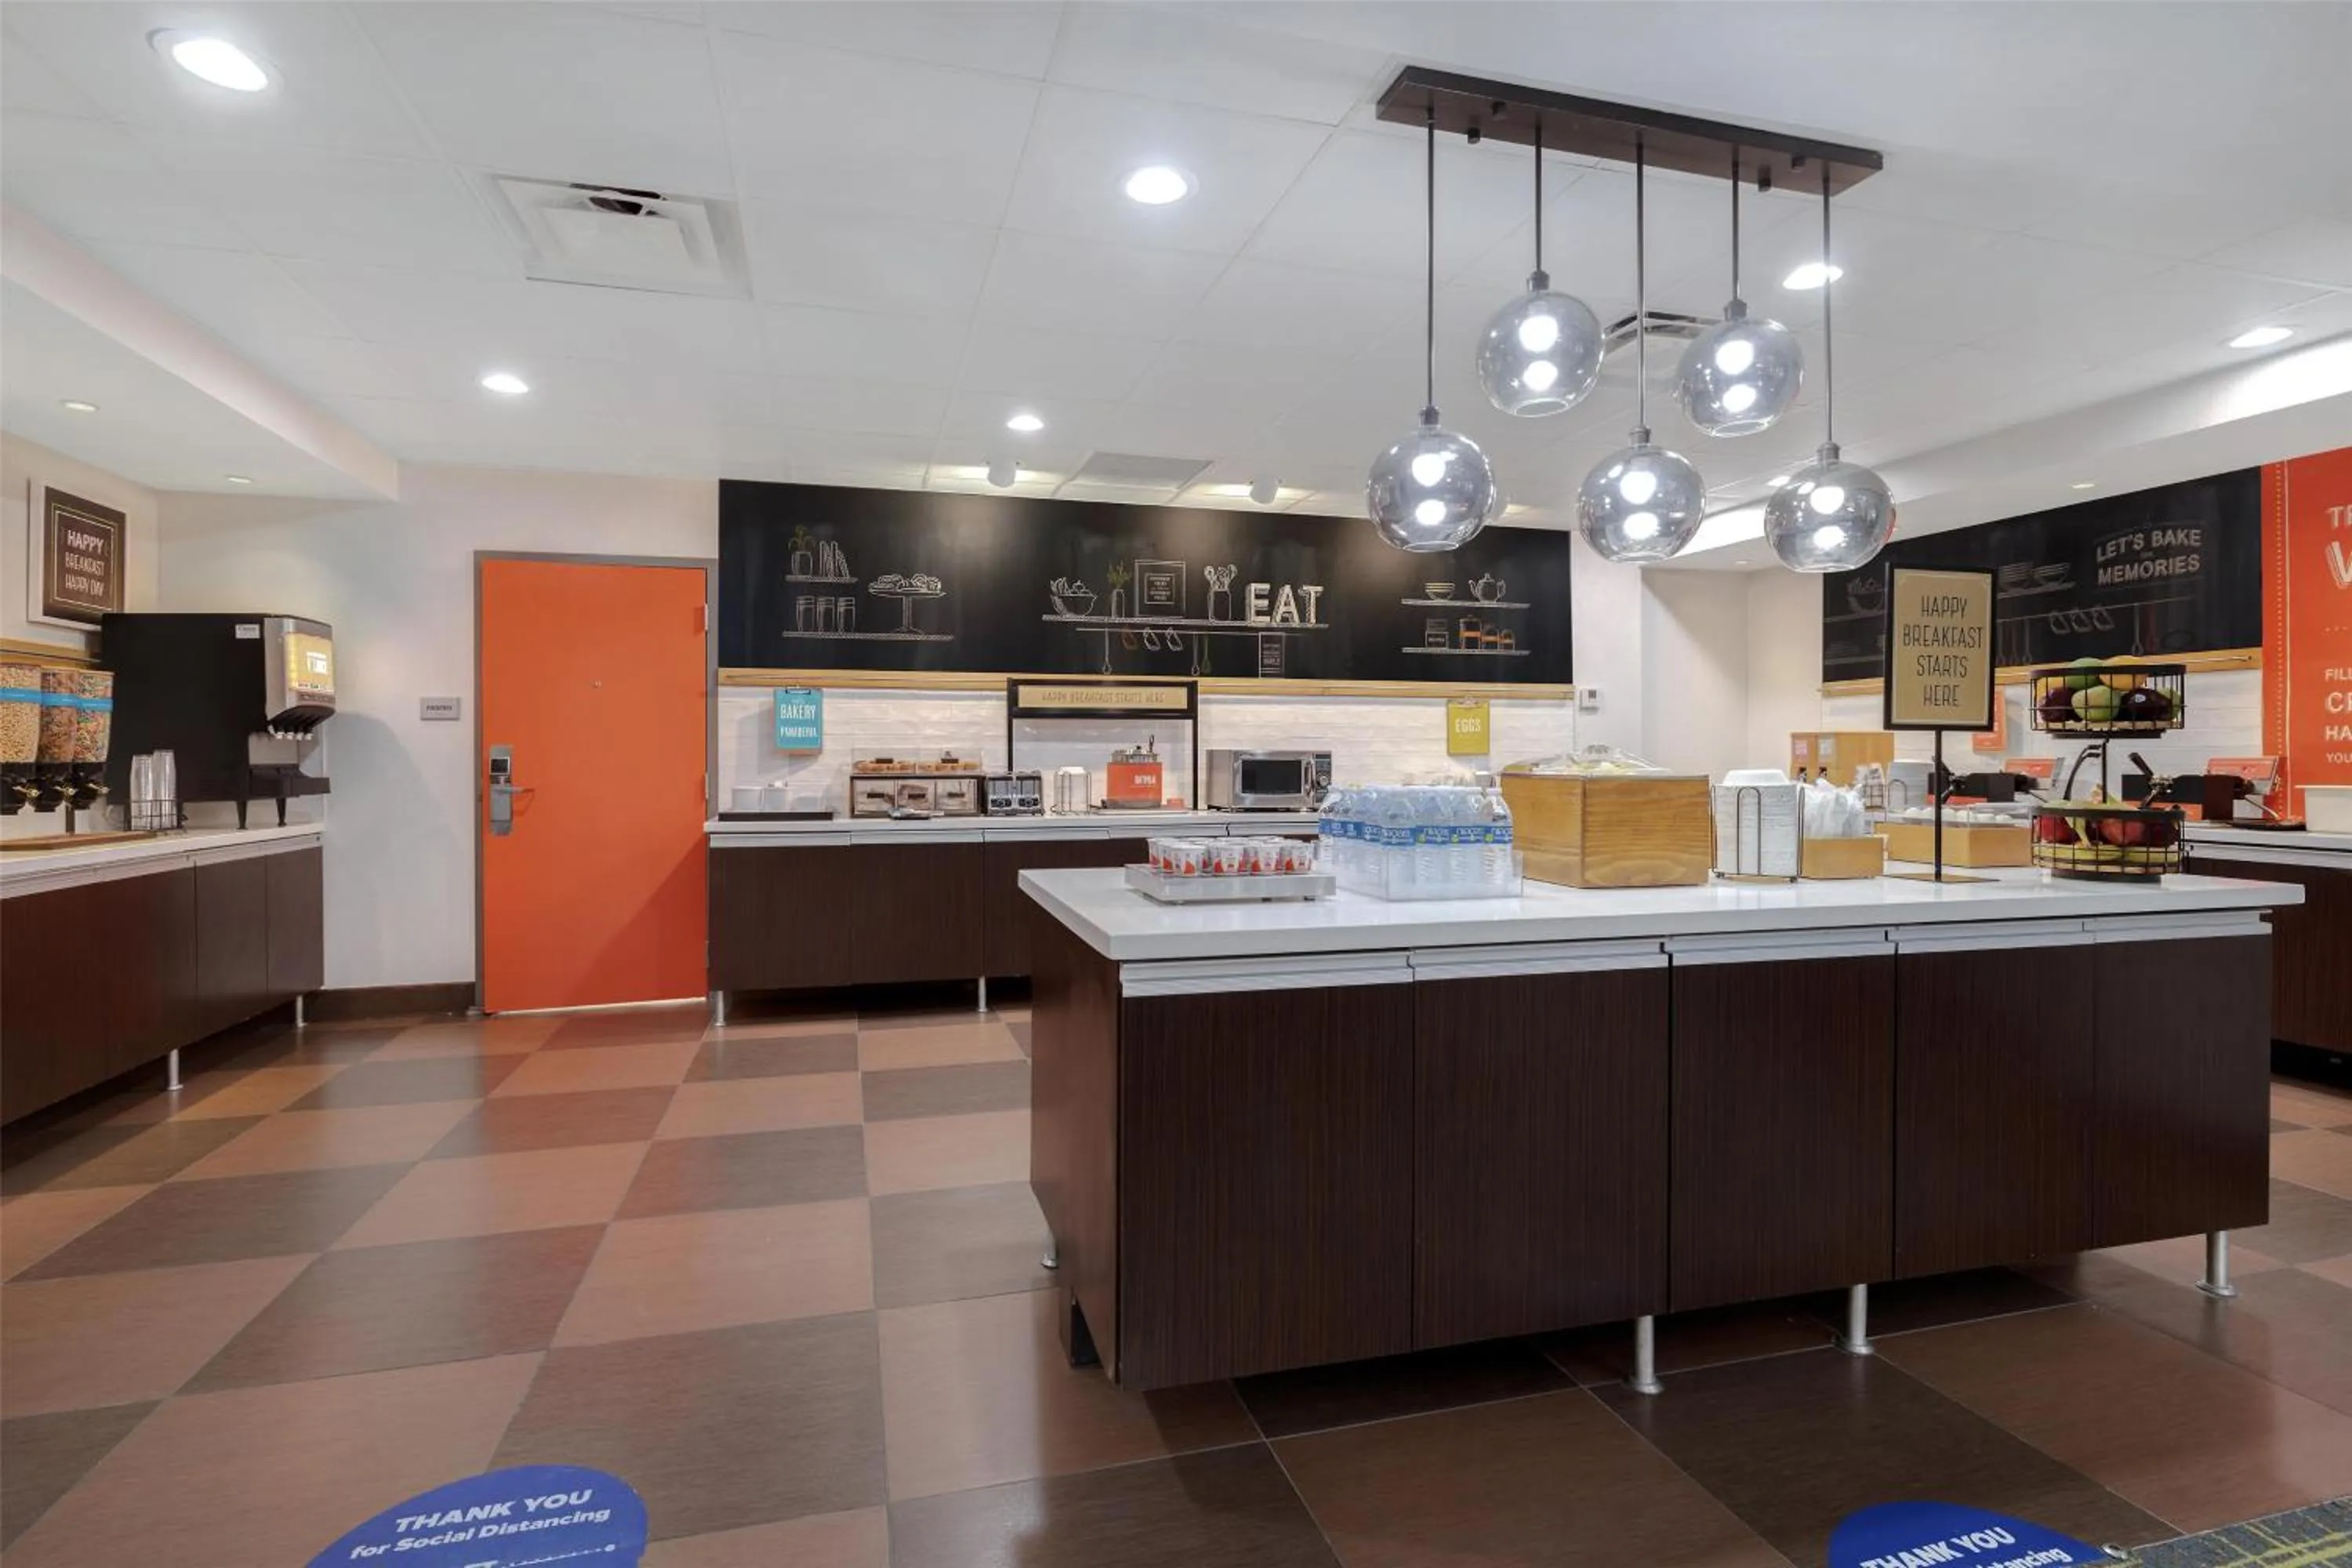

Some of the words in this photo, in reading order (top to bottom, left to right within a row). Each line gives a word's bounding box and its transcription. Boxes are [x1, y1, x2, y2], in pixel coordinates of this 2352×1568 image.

[67, 529, 104, 556] HAPPY
[2096, 532, 2145, 563] LET'S
[2151, 528, 2202, 548] BAKE
[2097, 554, 2201, 586] MEMORIES
[1245, 583, 1324, 627] EAT
[1921, 595, 1968, 619] HAPPY
[1903, 625, 1983, 649] BREAKFAST
[1917, 655, 1969, 678] STARTS
[1923, 684, 1961, 706] HERE
[780, 703, 816, 720] BAKERY
[1455, 717, 1481, 733] EGGS
[396, 1501, 516, 1533] THANK
[524, 1489, 593, 1513] YOU
[350, 1542, 391, 1560] for
[394, 1527, 476, 1552] Social
[477, 1501, 611, 1539] Distancing
[1949, 1526, 2016, 1553] YOU
[1976, 1548, 2074, 1568] ancing
